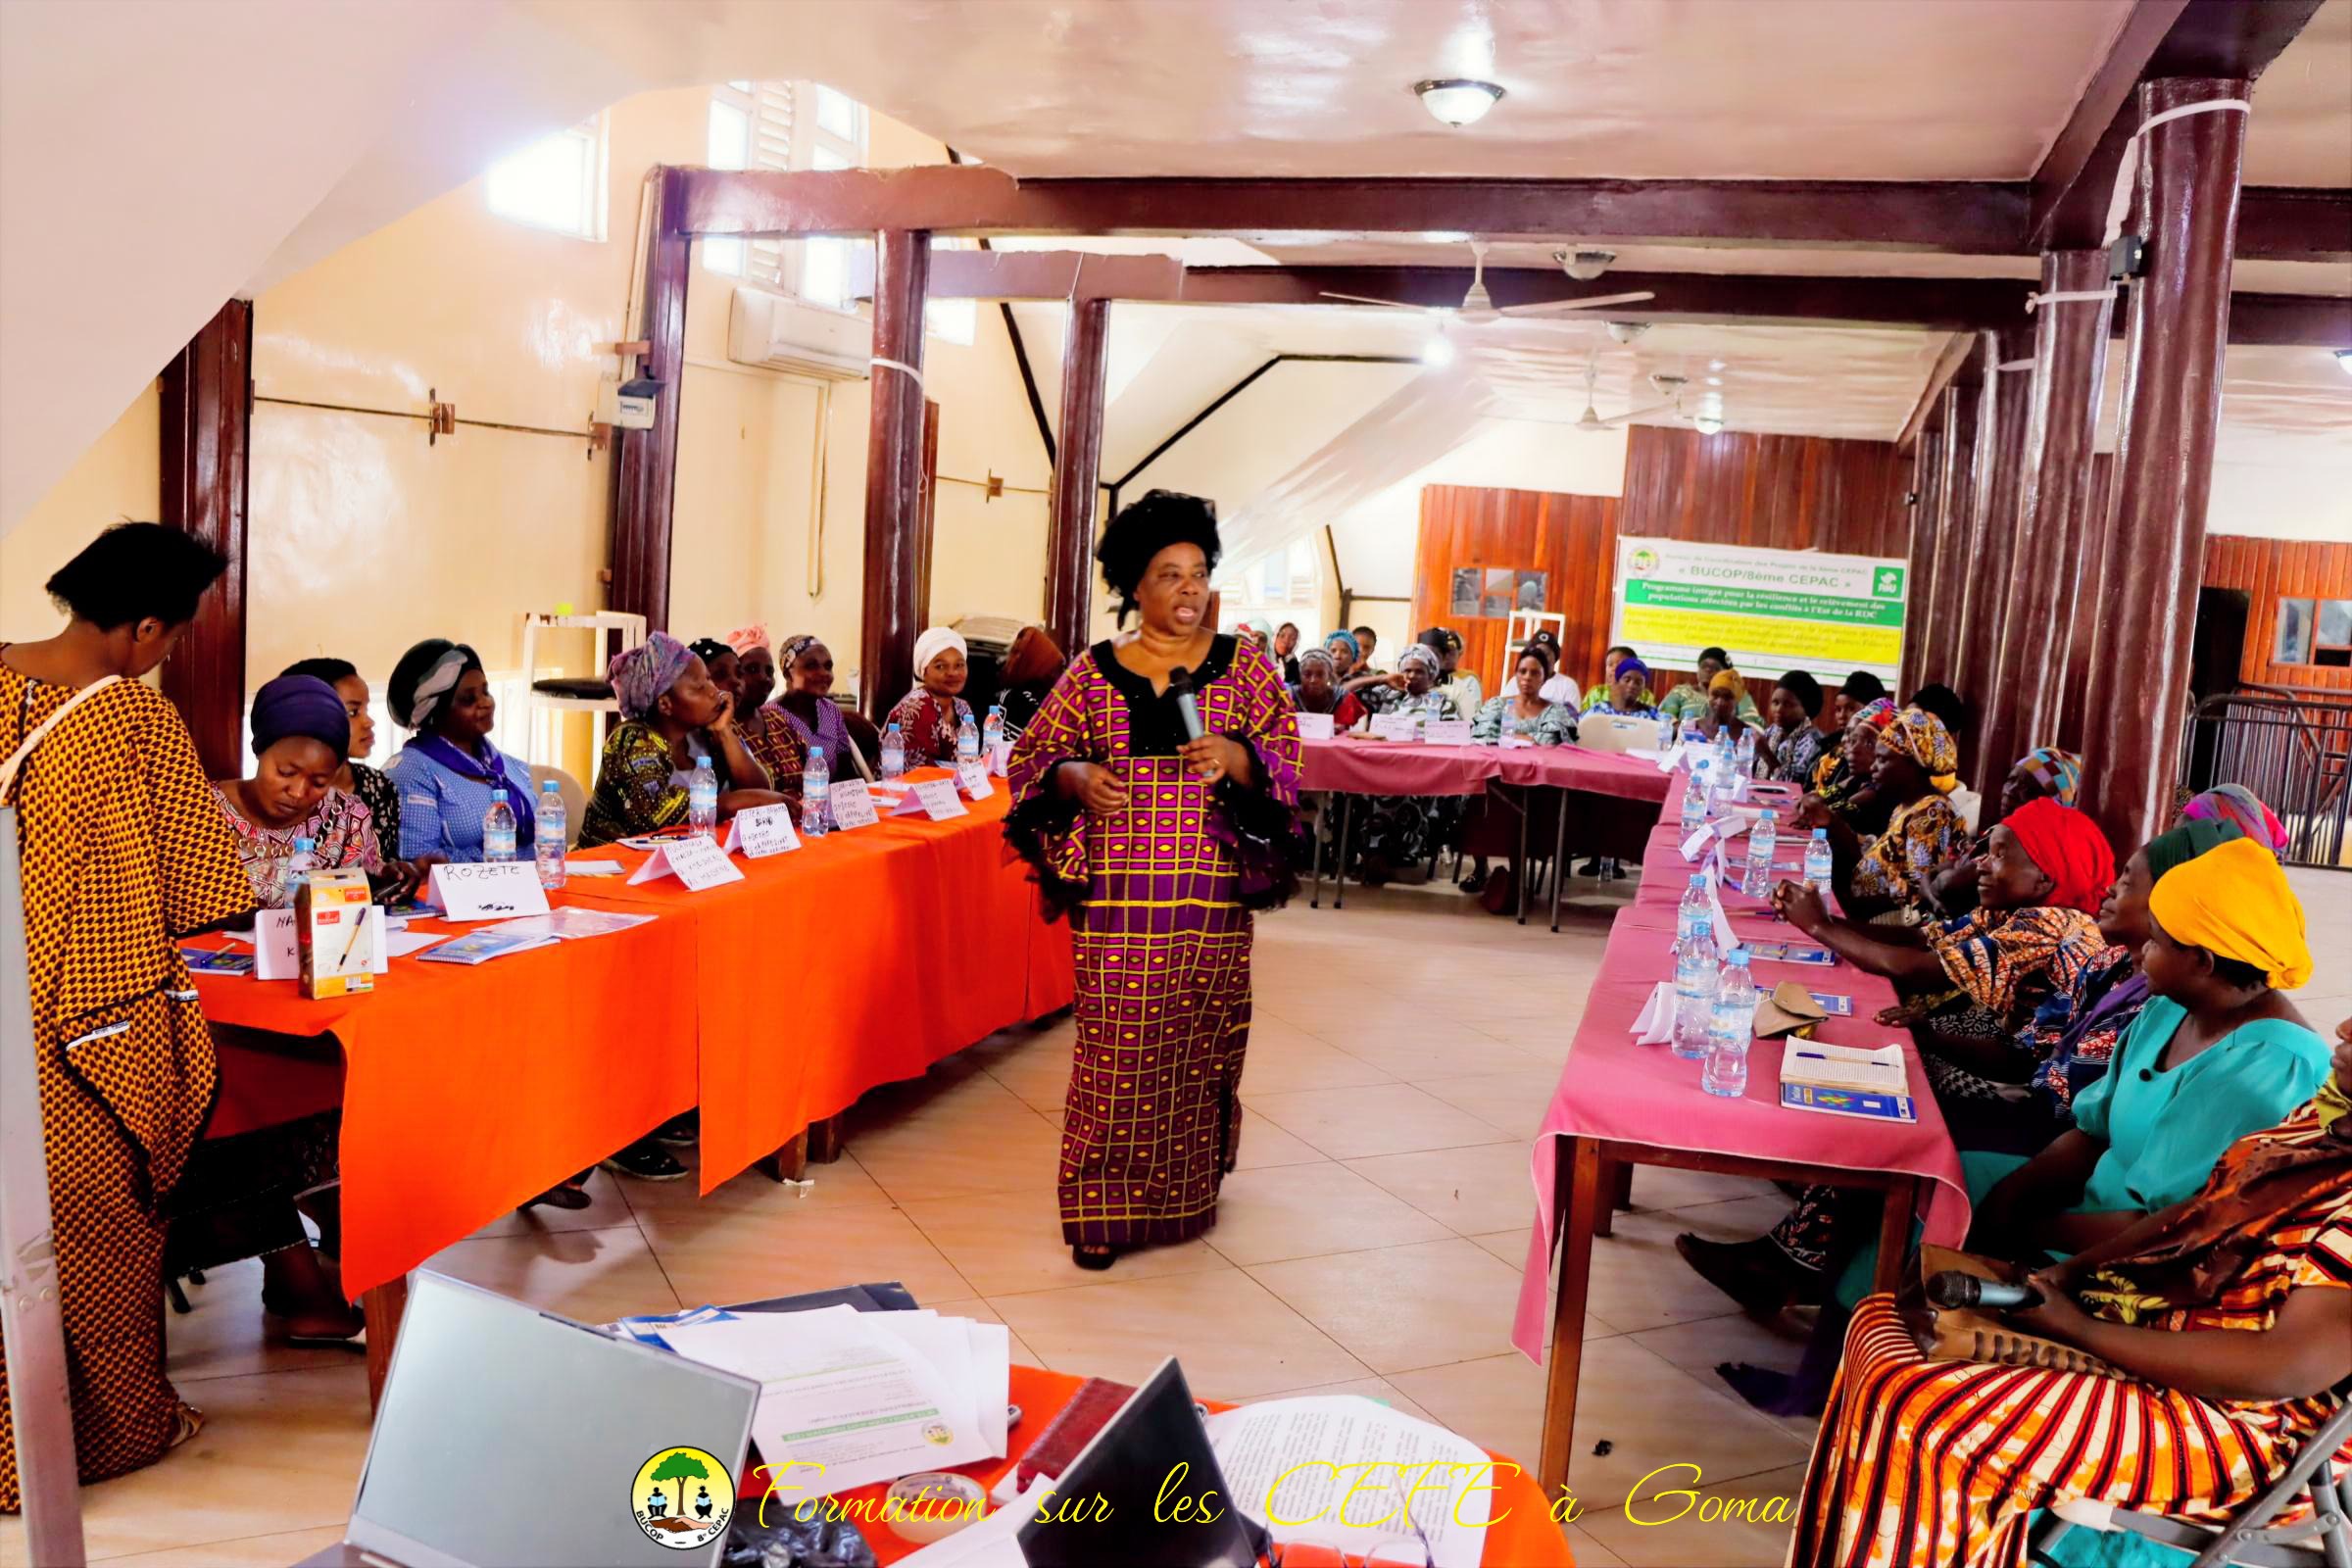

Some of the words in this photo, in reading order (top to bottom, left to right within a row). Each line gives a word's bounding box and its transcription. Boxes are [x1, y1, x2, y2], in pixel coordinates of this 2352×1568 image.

[1788, 573, 1839, 588] CEPAC
[1642, 582, 1690, 595] Programme
[1724, 590, 1744, 600] pour
[1756, 591, 1797, 604] résilience
[1873, 602, 1886, 611] des
[1647, 593, 1698, 605] populations
[1739, 601, 1754, 611] par
[1769, 603, 1803, 612] conflits
[1854, 609, 1877, 618] RDC
